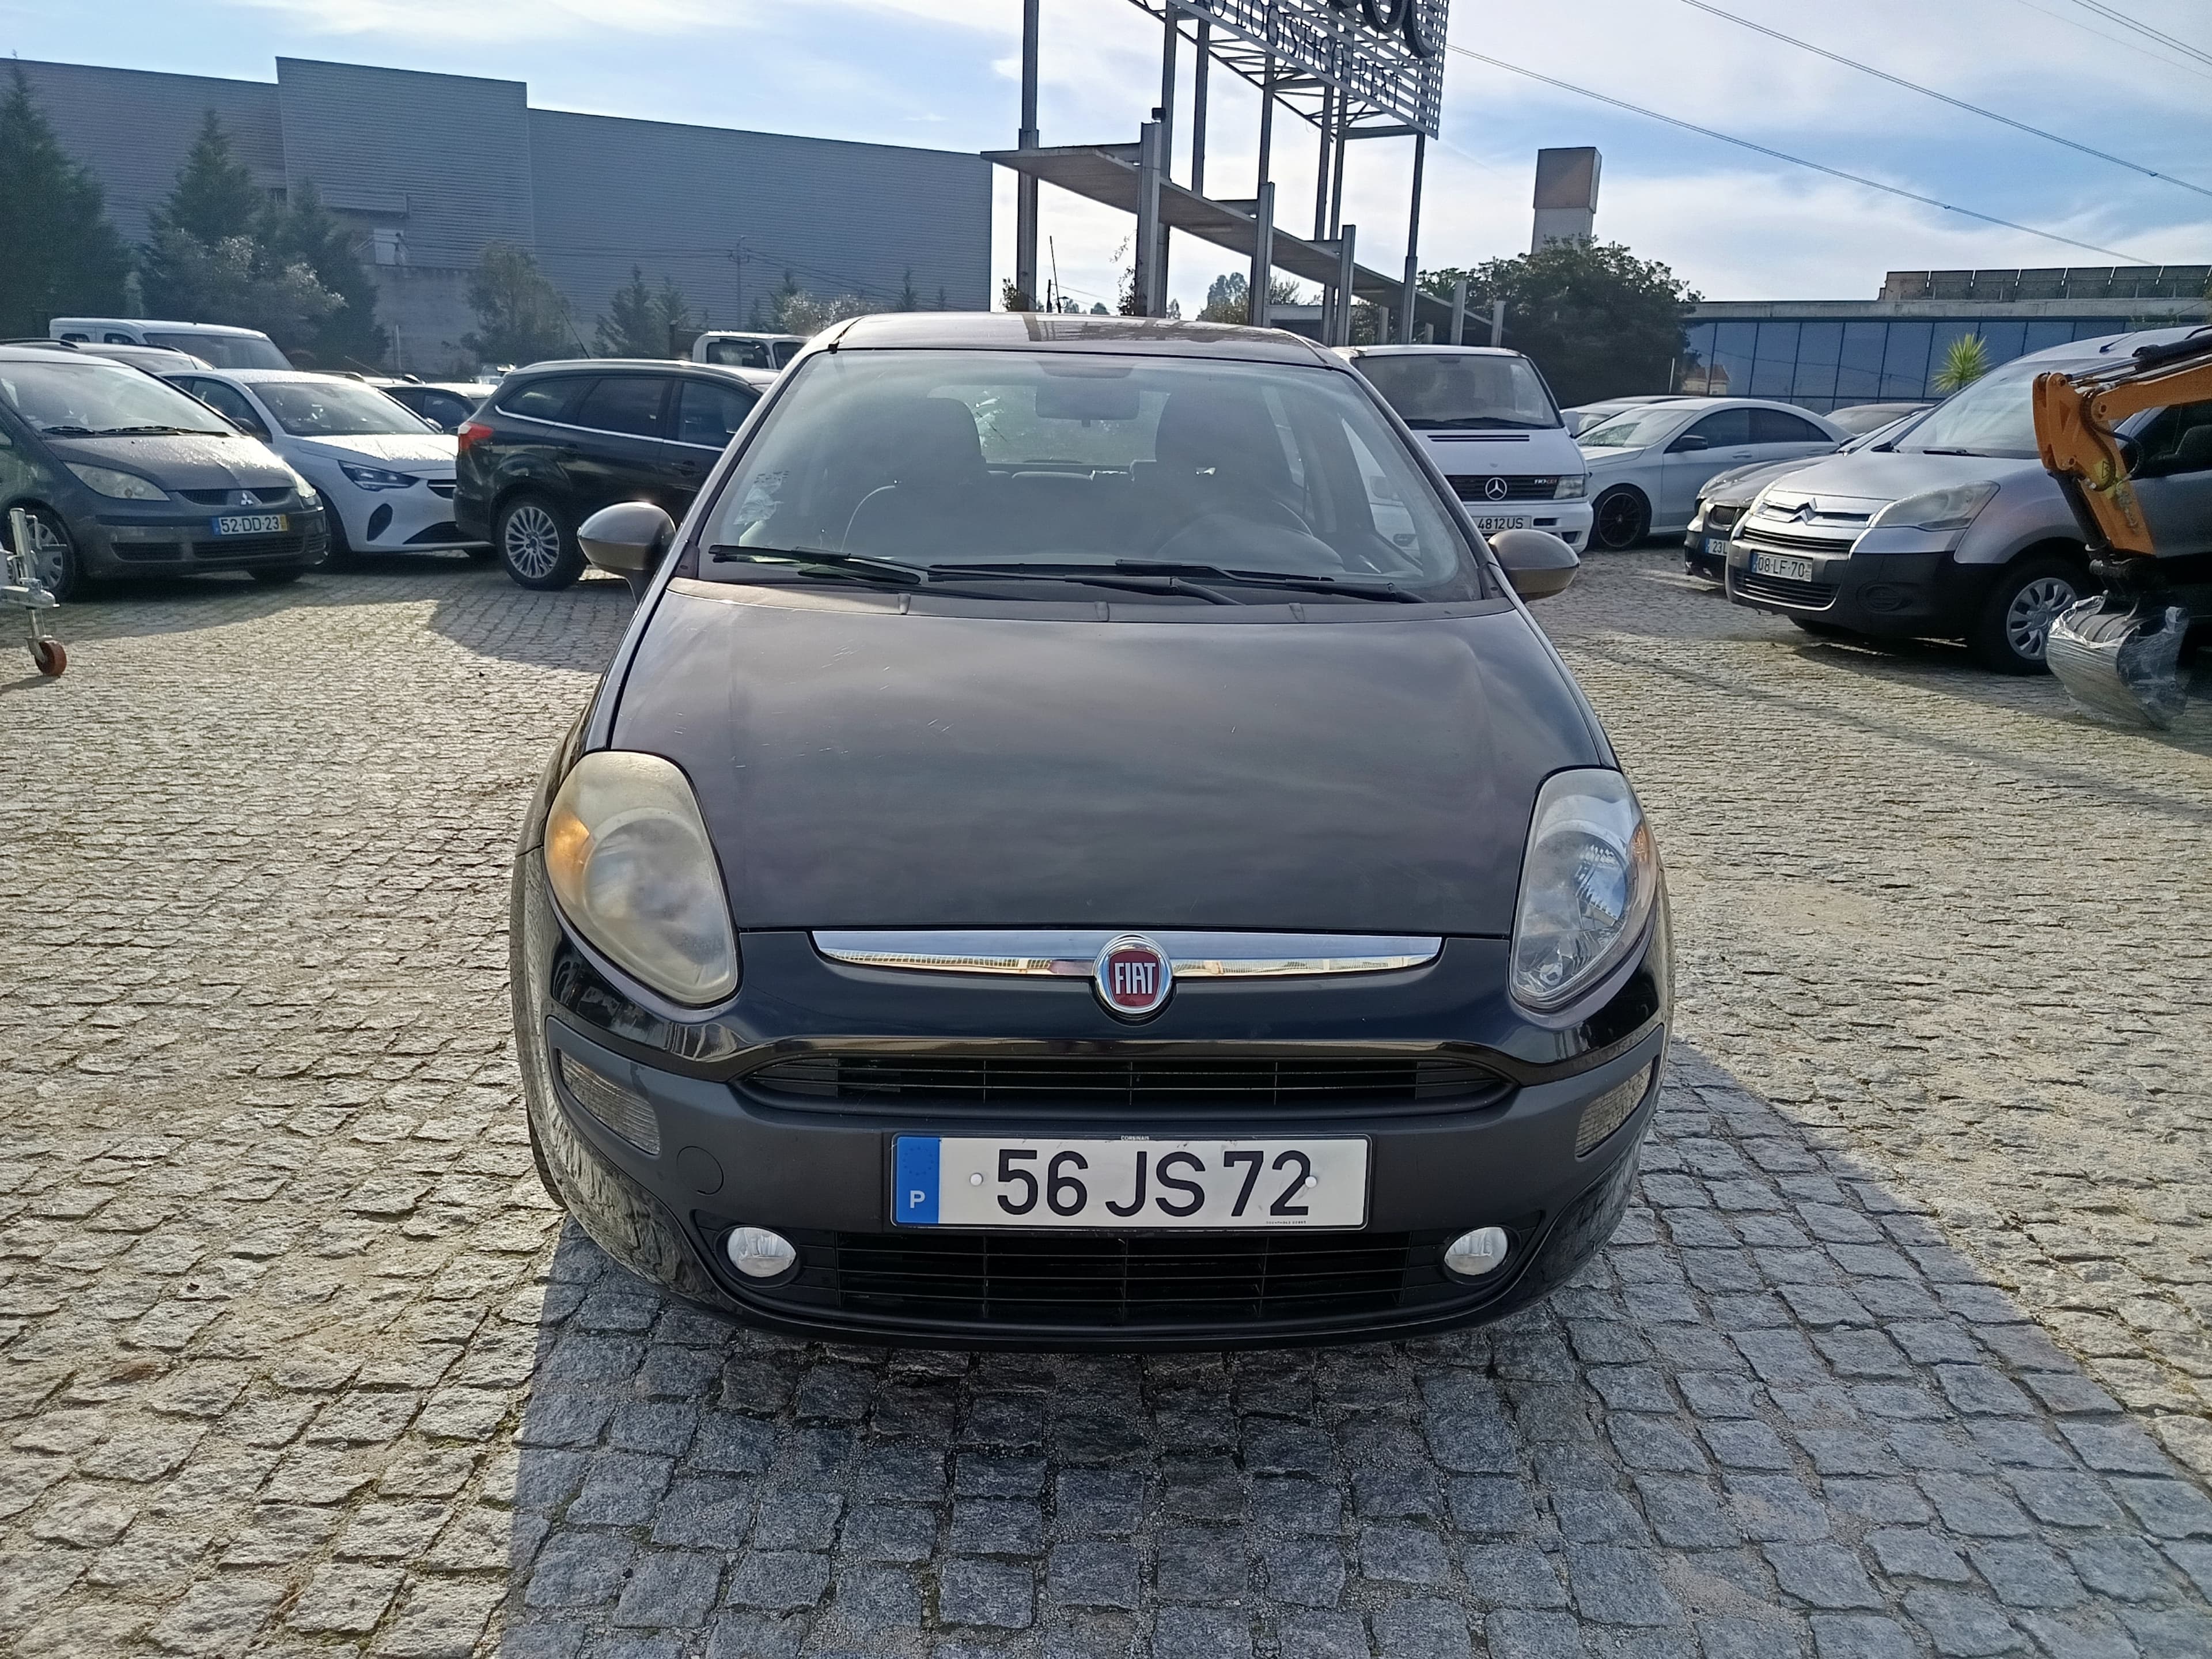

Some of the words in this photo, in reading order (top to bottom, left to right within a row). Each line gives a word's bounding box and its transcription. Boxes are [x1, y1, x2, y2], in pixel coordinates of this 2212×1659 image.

[1358, 55, 1402, 110] RENT
[1115, 963, 1156, 994] FIAT
[910, 1190, 925, 1208] P
[997, 1149, 1088, 1217] 56
[1105, 1151, 1206, 1217] JS
[1224, 1150, 1310, 1217] 72
